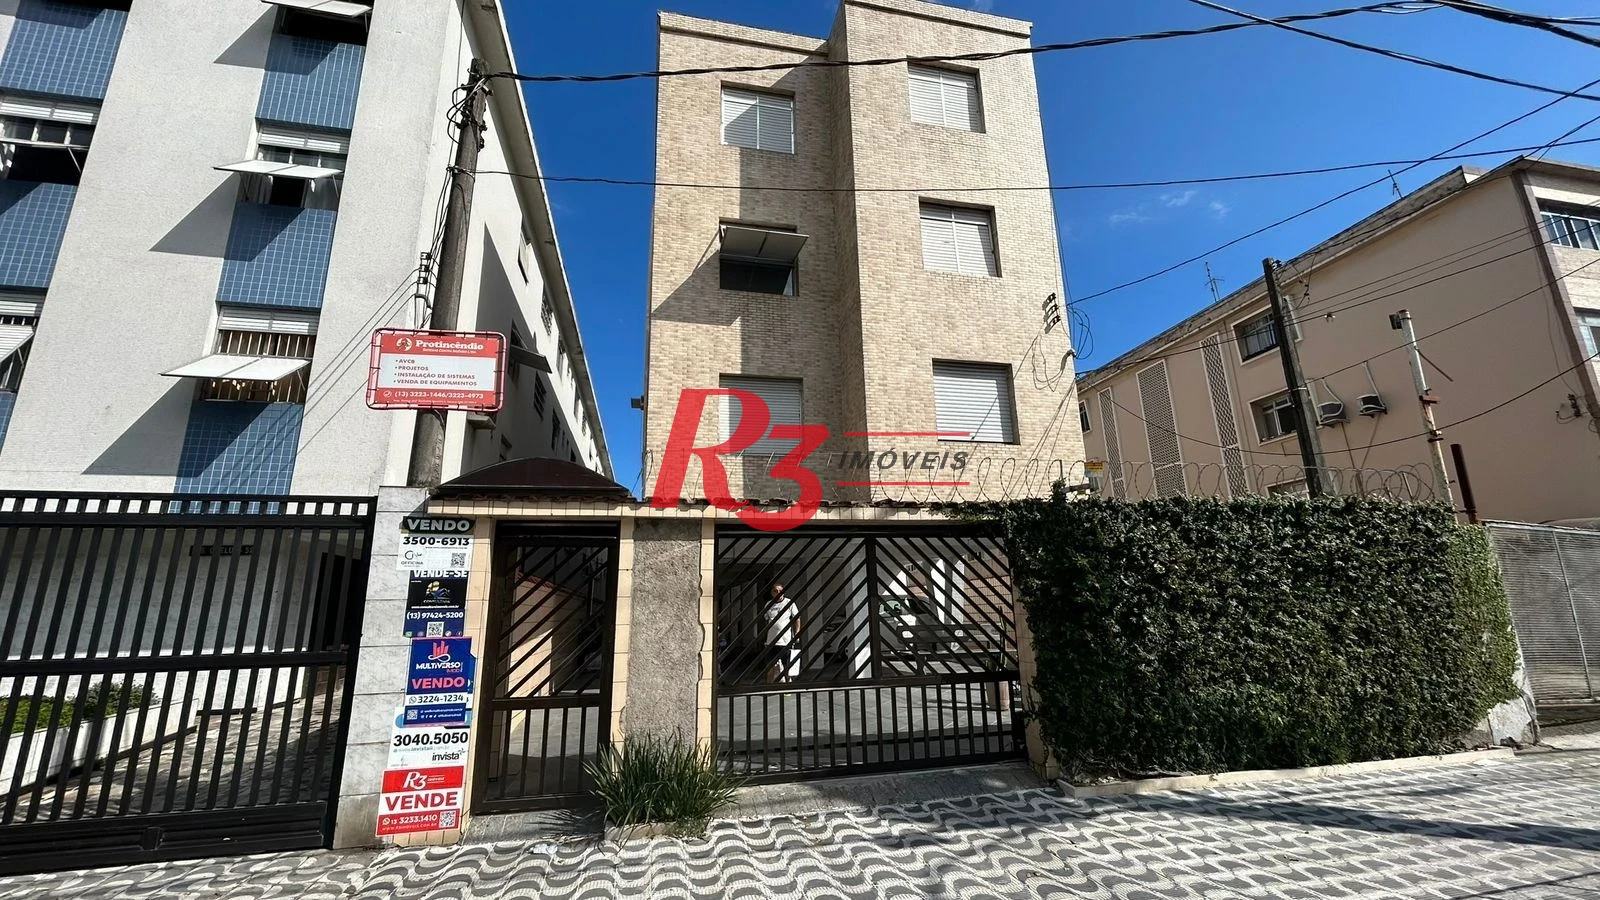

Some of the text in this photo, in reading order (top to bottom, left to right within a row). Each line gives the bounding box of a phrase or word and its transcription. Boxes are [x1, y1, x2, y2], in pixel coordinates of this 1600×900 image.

[415, 340, 484, 350] Protincêndio
[410, 391, 484, 399] 3223-1446/3223-4973
[407, 519, 470, 531] VENDO
[403, 536, 470, 546] 3500-6913
[413, 569, 468, 578] VENDE-SE
[406, 611, 464, 619] (13) 97424-5200
[411, 677, 465, 689] VENDO
[417, 694, 463, 703] 3224-1234
[393, 732, 468, 747] 3040.5050
[432, 751, 460, 761] invista
[403, 771, 428, 790] R3
[385, 791, 458, 811] VENDE
[399, 814, 438, 823] 3233.1410
